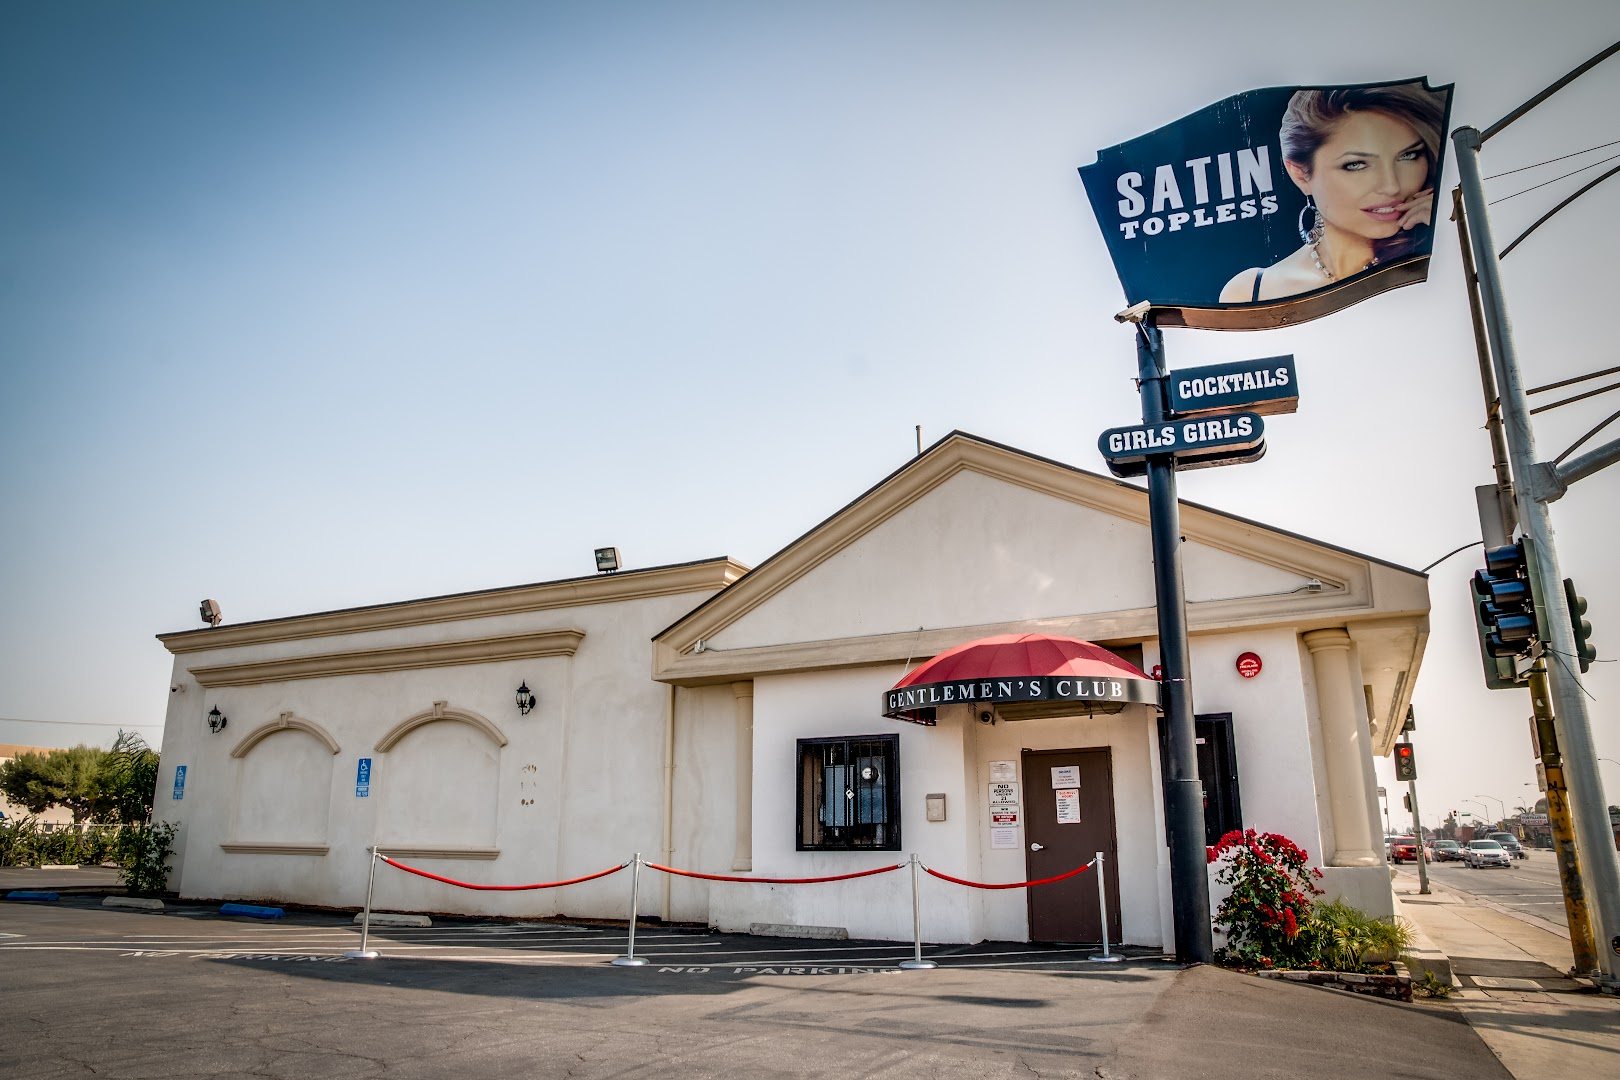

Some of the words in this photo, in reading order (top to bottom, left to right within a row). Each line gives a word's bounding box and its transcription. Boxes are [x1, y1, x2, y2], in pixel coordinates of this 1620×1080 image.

[1117, 146, 1273, 218] SATIN
[1120, 195, 1278, 240] TOPLESS
[1179, 367, 1289, 399] COCKTAILS
[1109, 426, 1176, 452] GIRLS
[1184, 417, 1253, 443] GIRLS
[889, 680, 1042, 709] GENTLEMEN'S
[1056, 680, 1123, 698] CLUB
[657, 966, 711, 974] NO
[733, 967, 902, 975] PARKING
